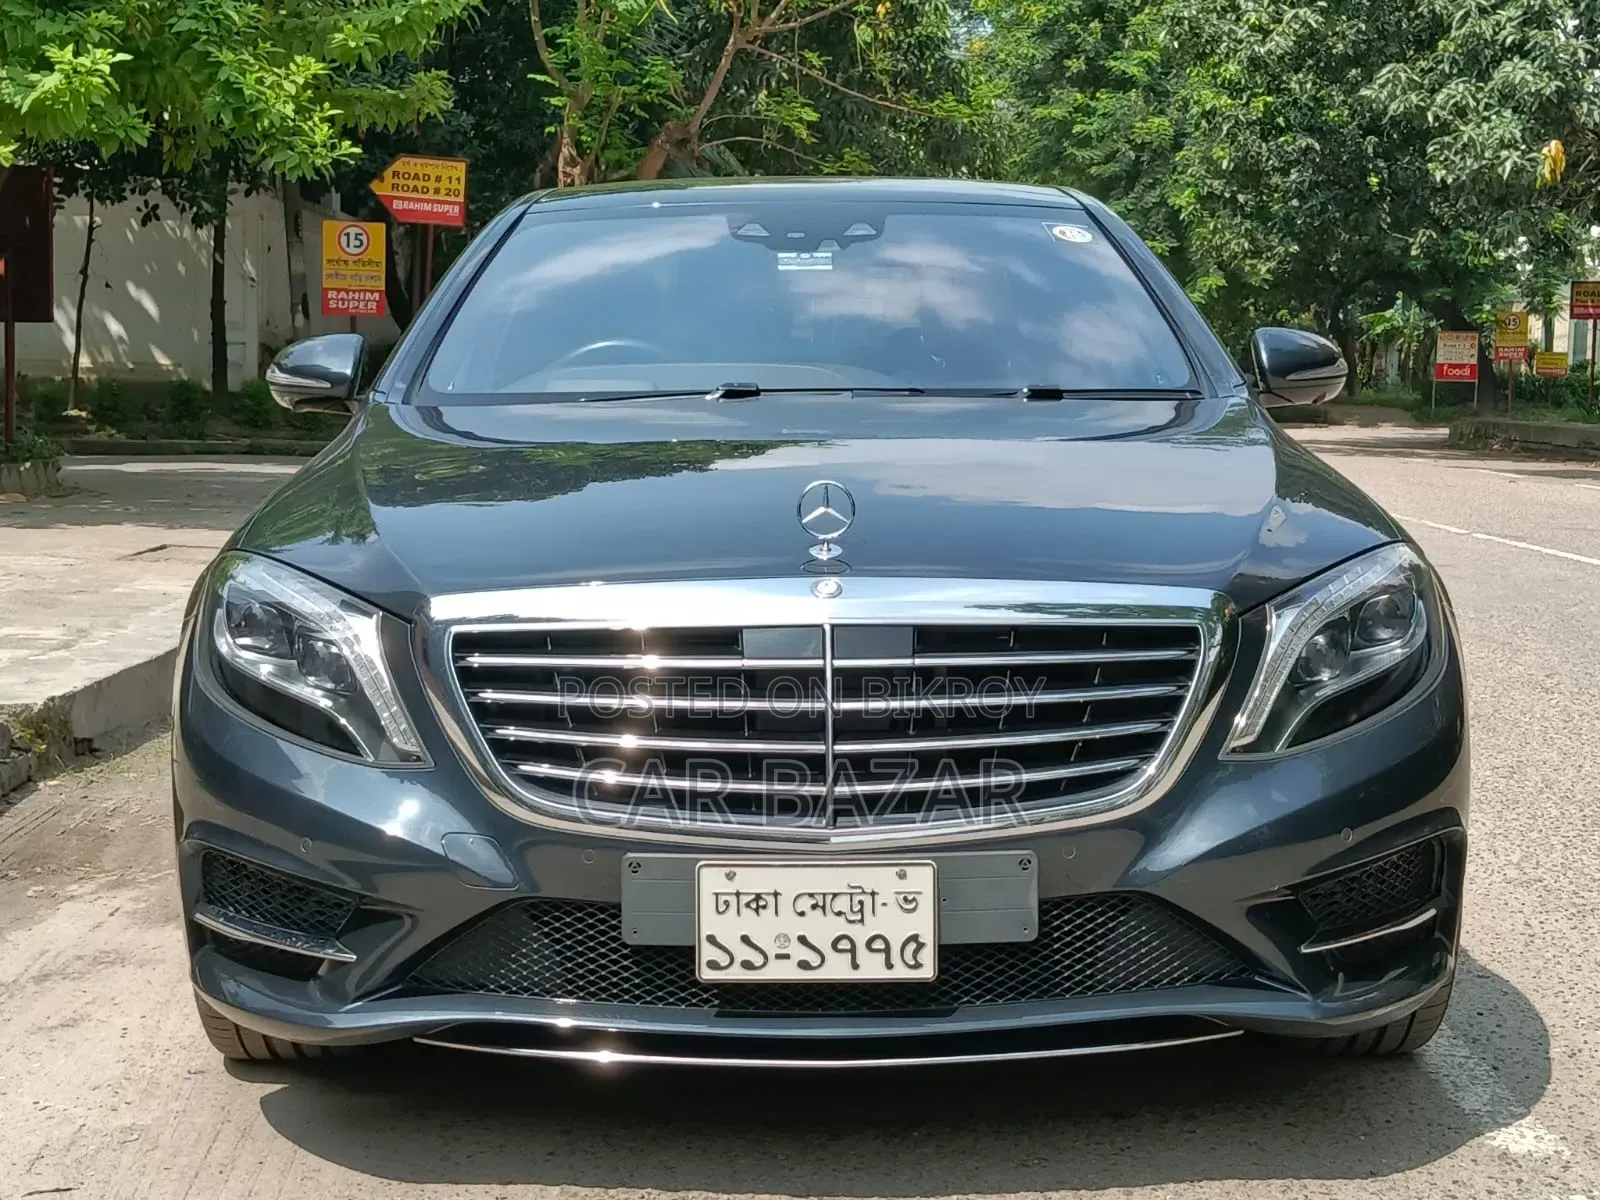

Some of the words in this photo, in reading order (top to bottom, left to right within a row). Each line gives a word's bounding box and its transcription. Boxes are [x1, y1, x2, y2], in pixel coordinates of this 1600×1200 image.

[391, 170, 431, 182] ROAD
[434, 174, 442, 184] #
[446, 175, 461, 185] 11
[391, 182, 430, 195] ROAD
[433, 187, 441, 196] #
[444, 187, 461, 198] 20
[402, 200, 432, 212] RAHIM
[432, 202, 460, 214] SUPER
[343, 231, 364, 249] 15
[327, 290, 380, 301] RAHIM
[1575, 290, 1600, 299] ROA
[328, 300, 378, 310] SUPER
[1507, 317, 1518, 327] 15
[1443, 364, 1471, 377] foodi
[712, 889, 782, 917] ঢাকা
[705, 932, 928, 971] ১১-১৭৭৫
